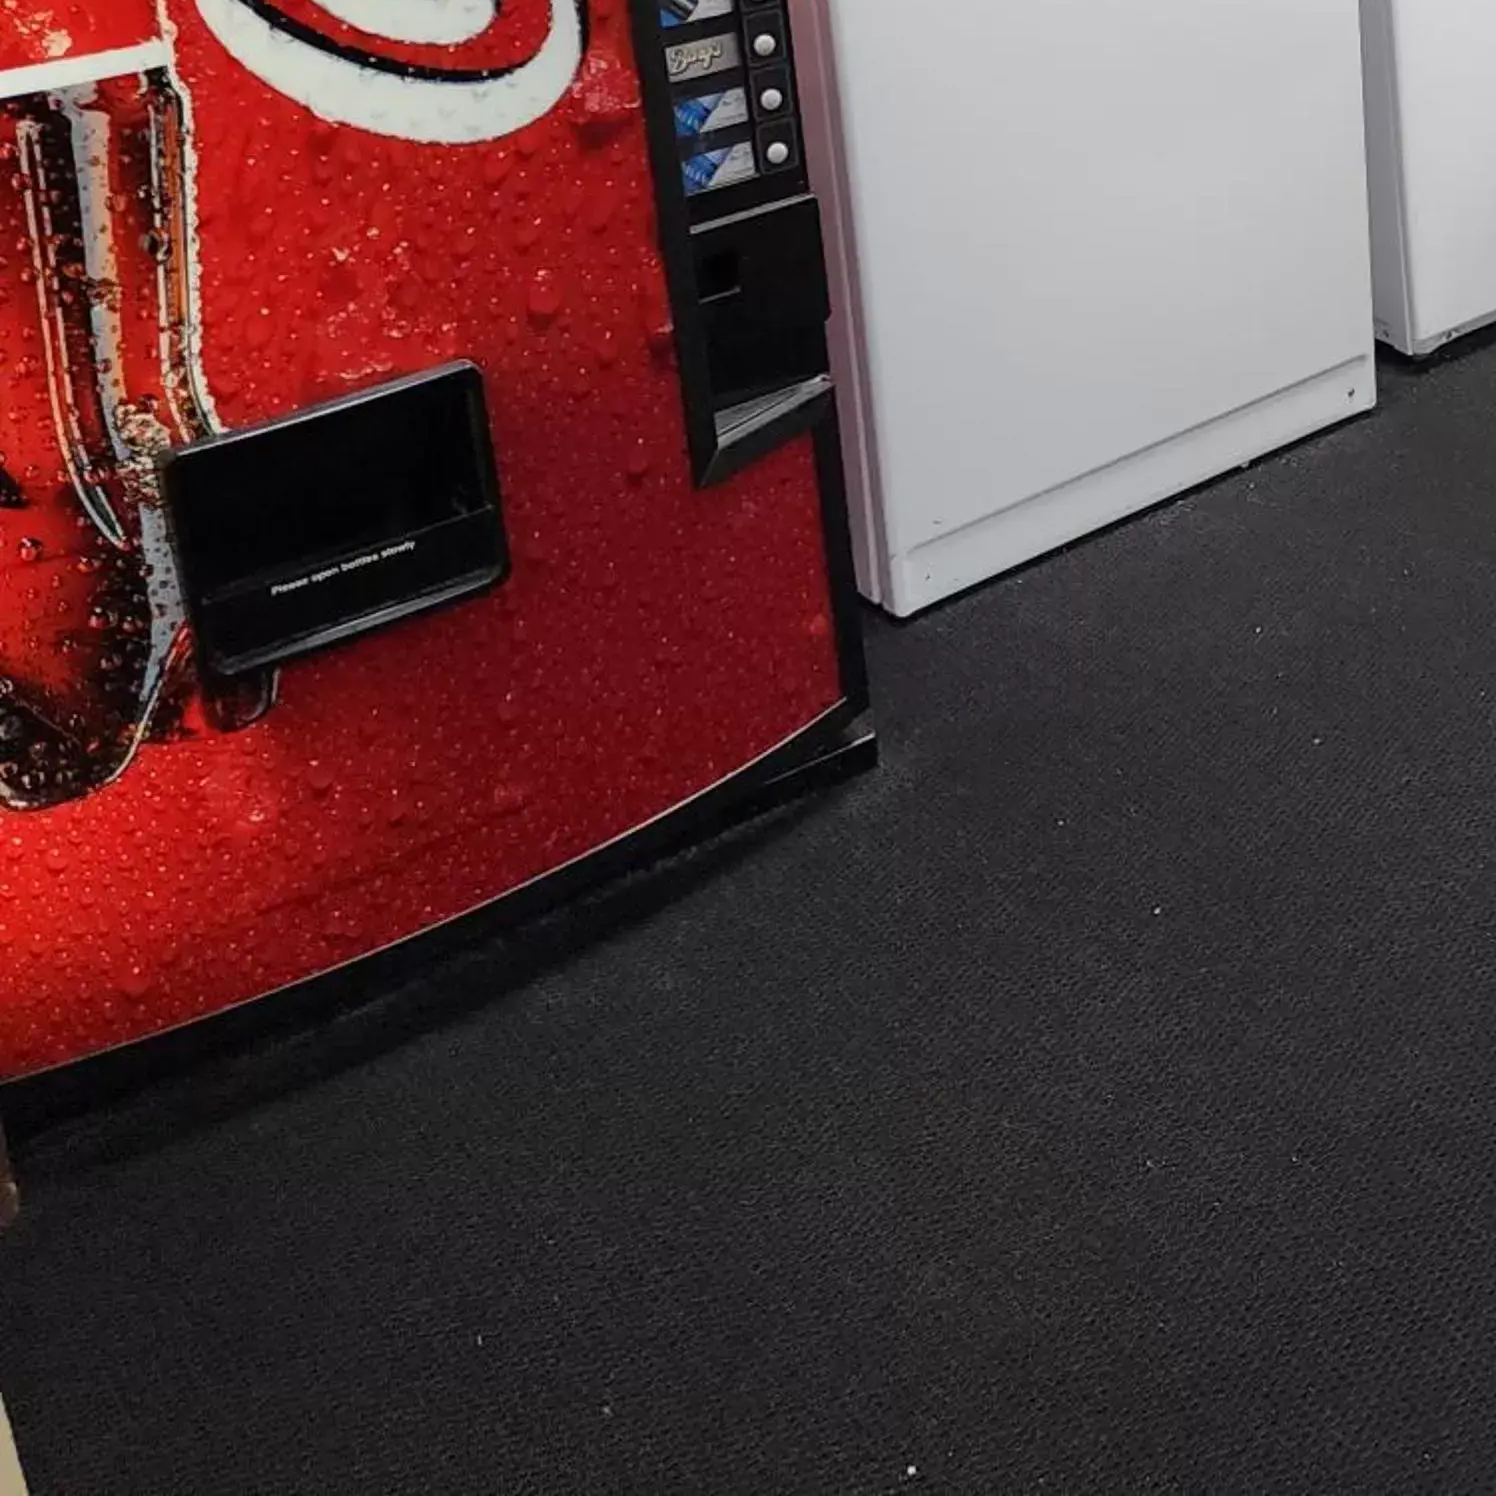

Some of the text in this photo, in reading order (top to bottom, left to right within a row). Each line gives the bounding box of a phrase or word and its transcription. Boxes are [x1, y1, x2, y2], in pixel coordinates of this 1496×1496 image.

[310, 566, 340, 583] open
[340, 553, 379, 572] bottles
[380, 540, 416, 558] slowly
